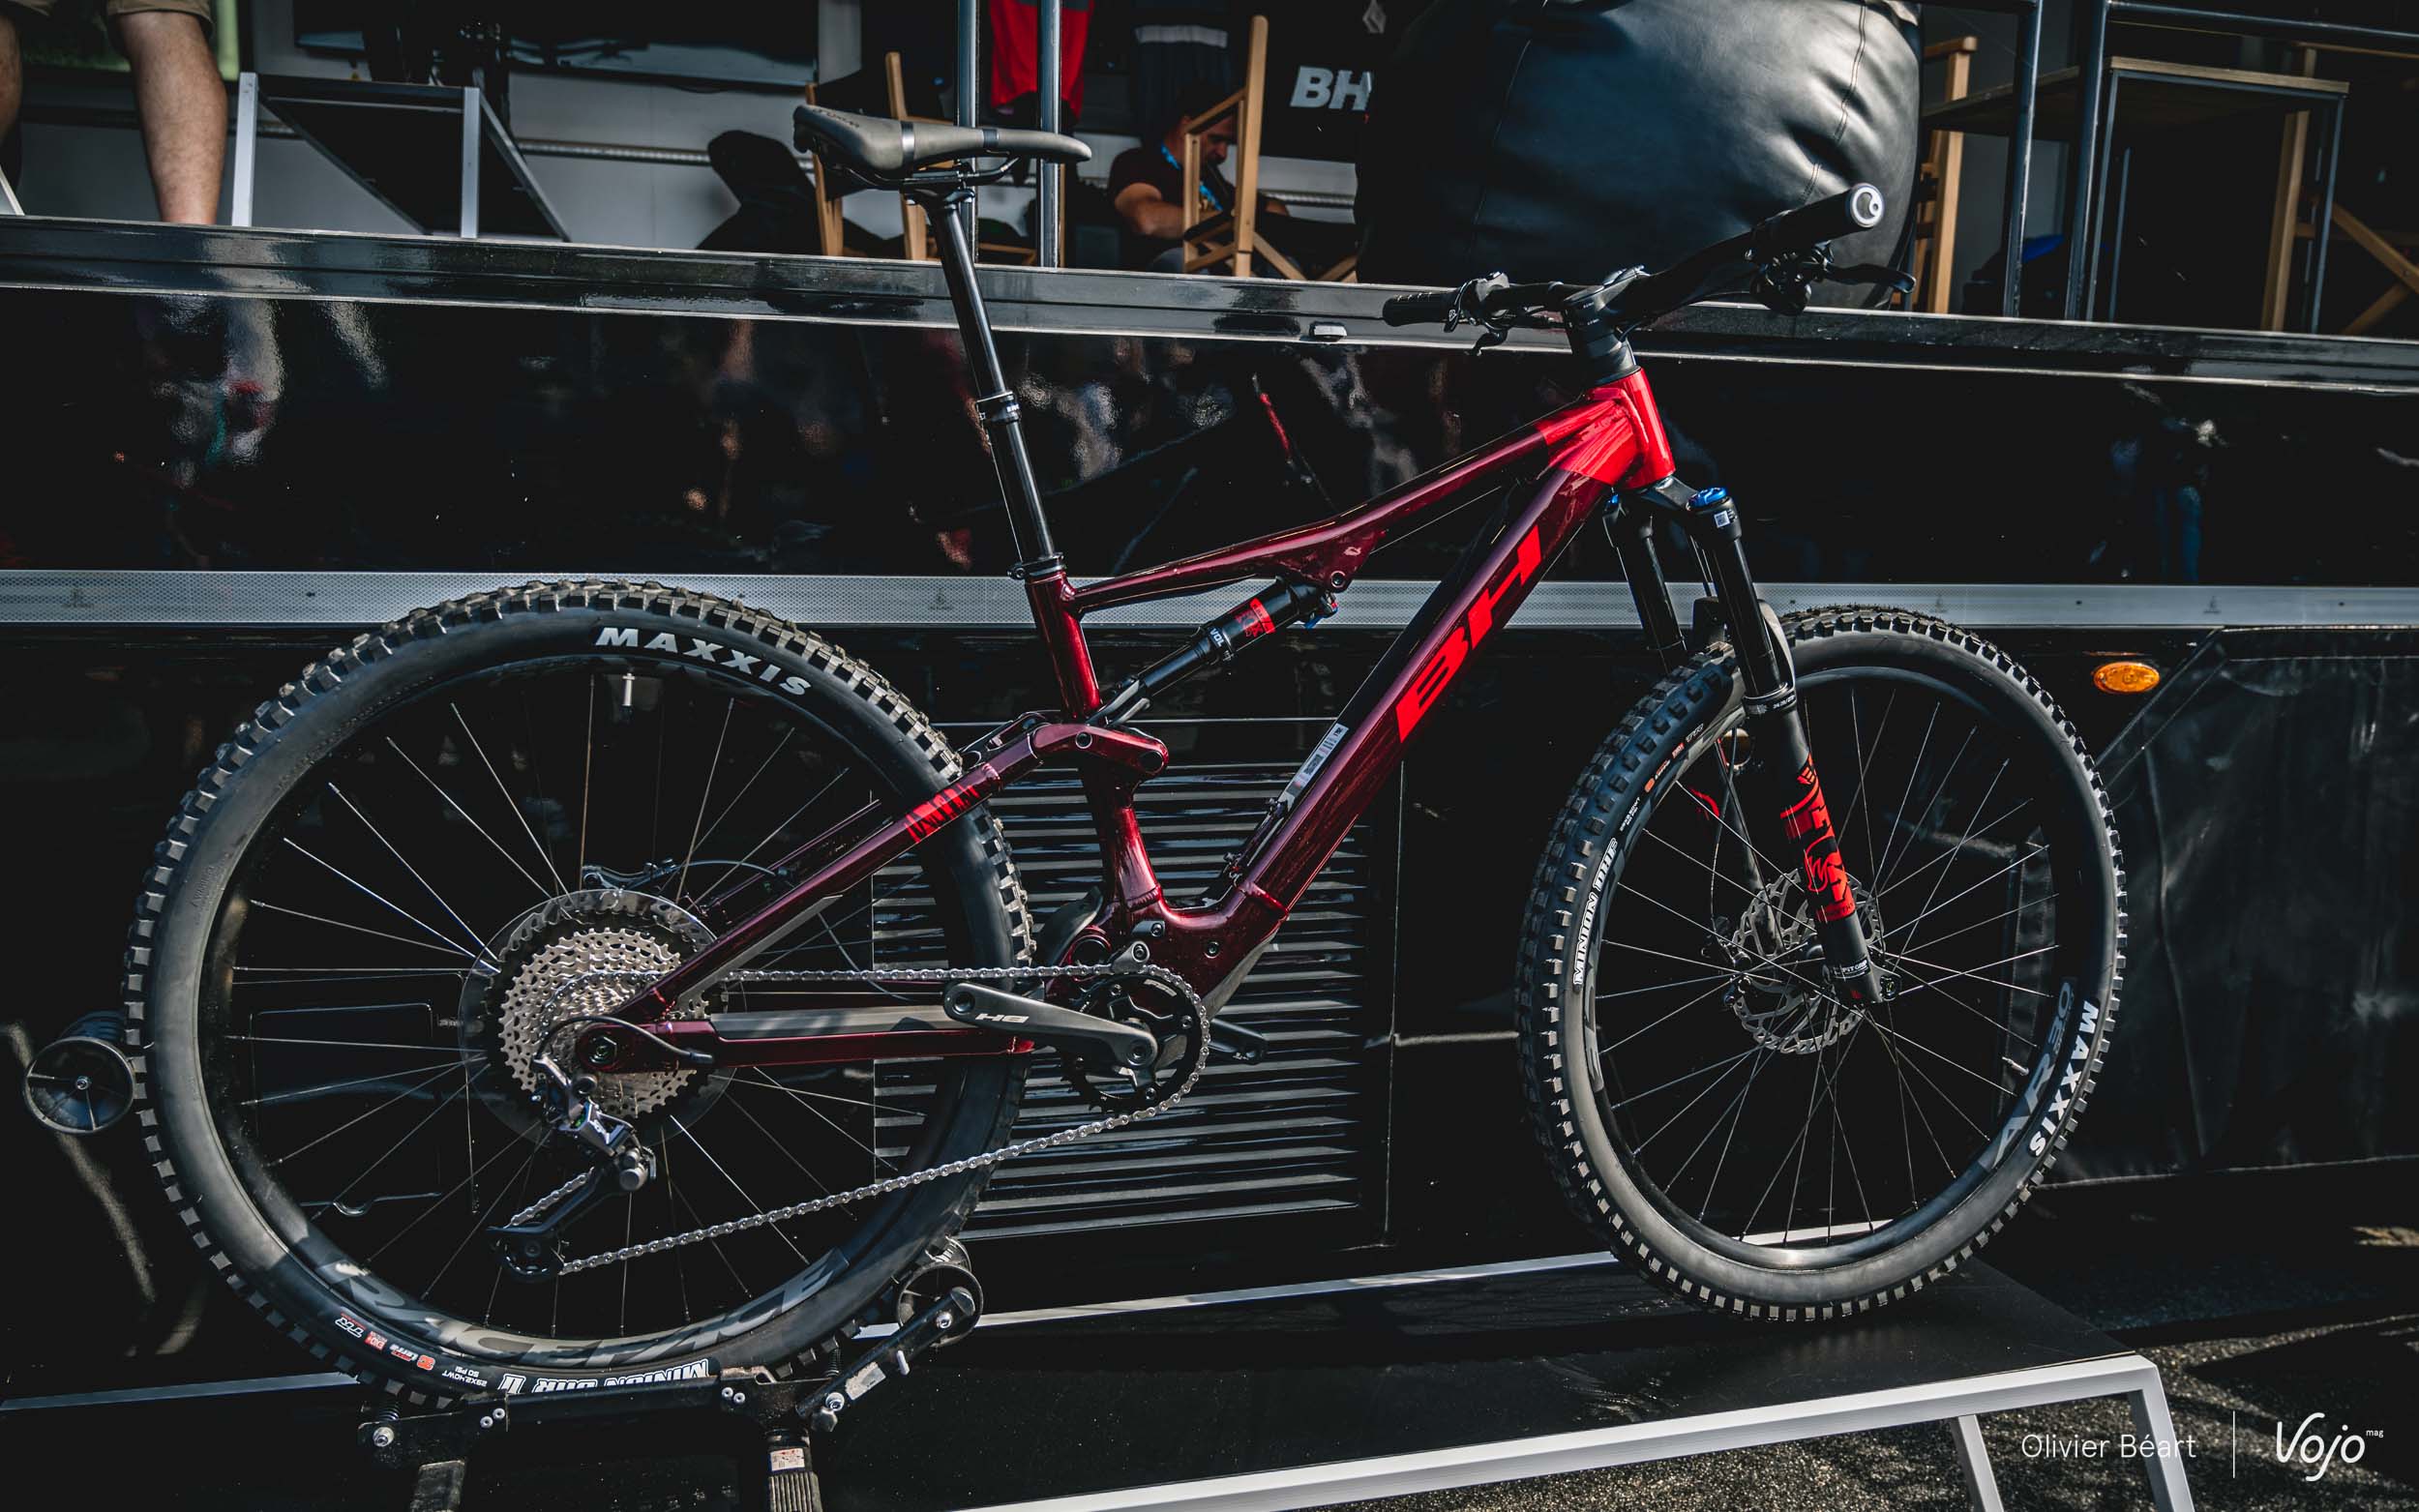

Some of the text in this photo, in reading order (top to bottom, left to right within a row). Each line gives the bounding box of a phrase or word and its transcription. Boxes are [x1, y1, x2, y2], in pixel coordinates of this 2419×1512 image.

[1290, 65, 1371, 111] BH
[594, 625, 811, 697] MAXXIS
[1395, 524, 1541, 743] BH
[1572, 837, 1618, 986] MINION DHF
[2028, 999, 2100, 1157] MAXXIS
[314, 1253, 834, 1367] RACEFACE
